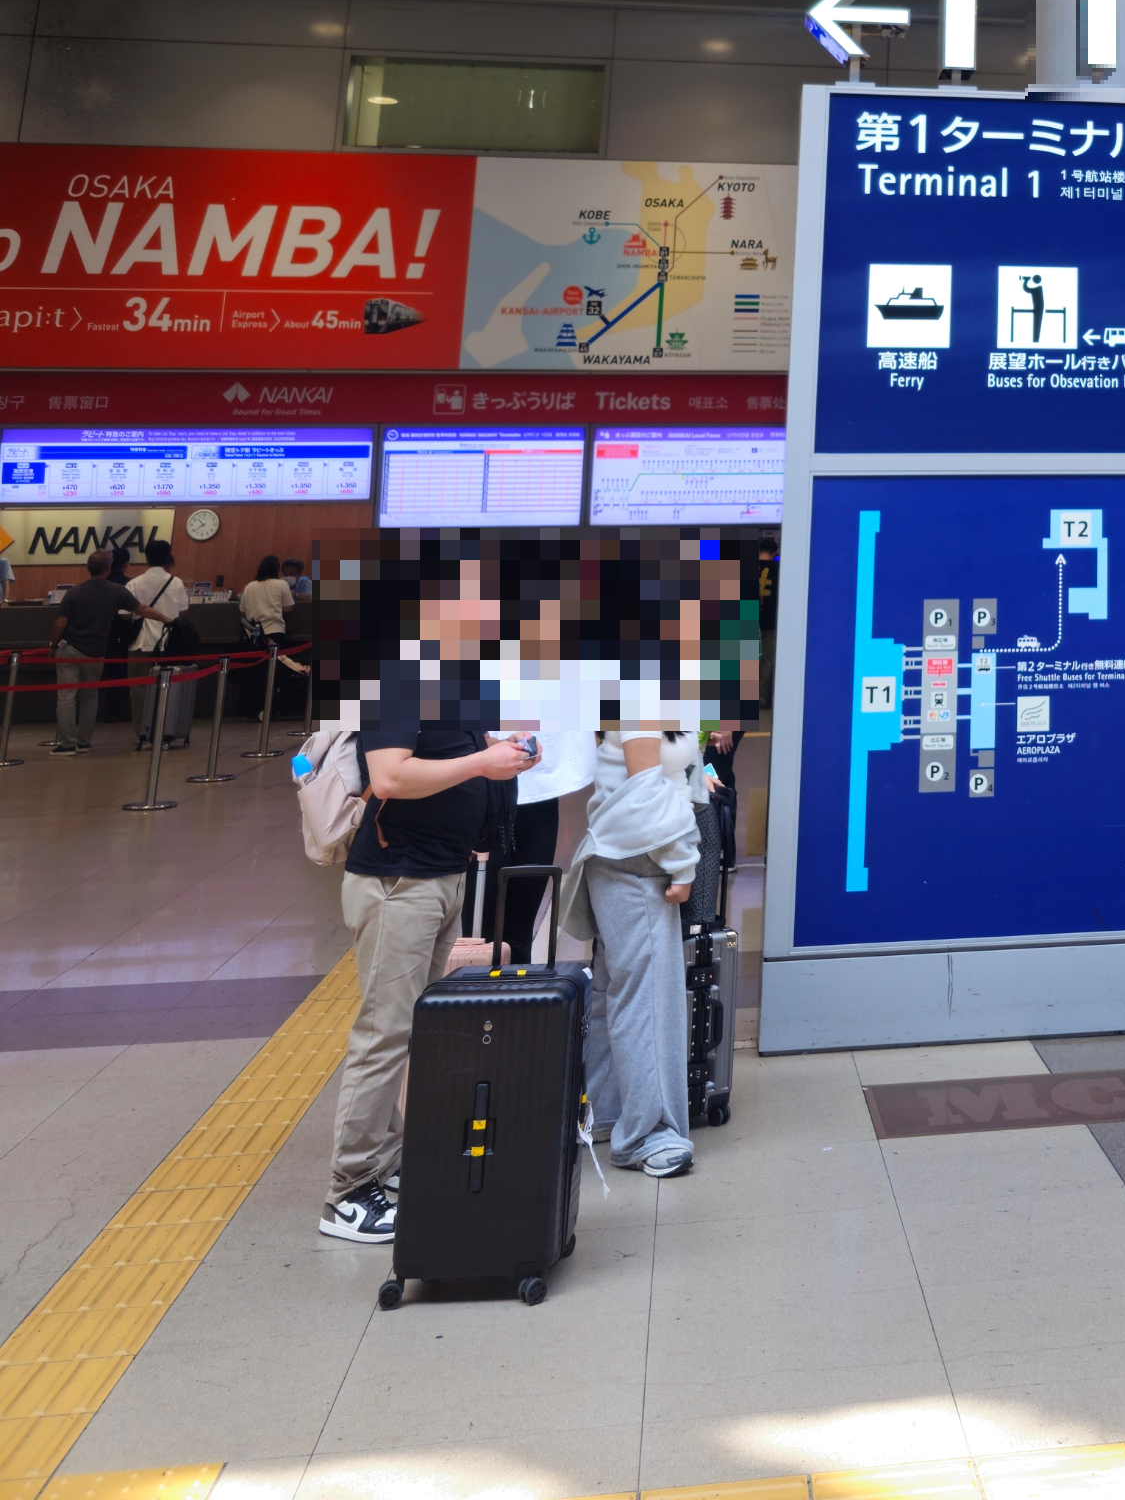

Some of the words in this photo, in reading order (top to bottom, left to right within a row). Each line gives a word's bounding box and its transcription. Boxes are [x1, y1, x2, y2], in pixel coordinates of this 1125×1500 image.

[67, 173, 175, 199] OSAKA
[858, 163, 1008, 198] Terminal
[1027, 170, 1041, 198] 1
[717, 182, 756, 192] KYOTO
[1060, 186, 1124, 201] 제1터미널
[644, 198, 685, 208] OSAKA
[579, 210, 611, 220] KOBE
[40, 200, 442, 280] NAMBA!
[730, 239, 764, 249] NARA
[622, 249, 658, 257] NAMBA
[232, 310, 265, 321] Airport
[500, 306, 584, 317] KANSAI-AIRPORT
[587, 306, 600, 315] 32
[87, 321, 119, 332] Fastest
[231, 319, 268, 331] Express
[284, 319, 310, 329] About
[582, 355, 651, 366] WAKAYAMA
[878, 351, 938, 370] 高速船
[889, 372, 924, 391] Ferry
[987, 373, 1023, 388] Buses
[1027, 373, 1046, 388] for
[1050, 373, 1120, 389] Obsevation
[259, 386, 334, 404] NANKAI
[472, 390, 576, 411] きっぷうりば
[595, 391, 671, 411] Tickets
[48, 395, 109, 411] 售票窗口
[688, 395, 728, 411] 매표소
[232, 408, 260, 416] Bound
[261, 408, 274, 416] for
[276, 408, 297, 416] Good
[299, 408, 322, 416] Times
[1062, 518, 1088, 540] T2
[1017, 673, 1032, 682] Free
[1034, 673, 1061, 682] Shuttle
[1062, 672, 1082, 681] Buses
[1084, 672, 1095, 681] for
[865, 685, 891, 705] T1
[1016, 732, 1076, 745] エアロプラザ
[1016, 746, 1060, 755] AEROPLAZA
